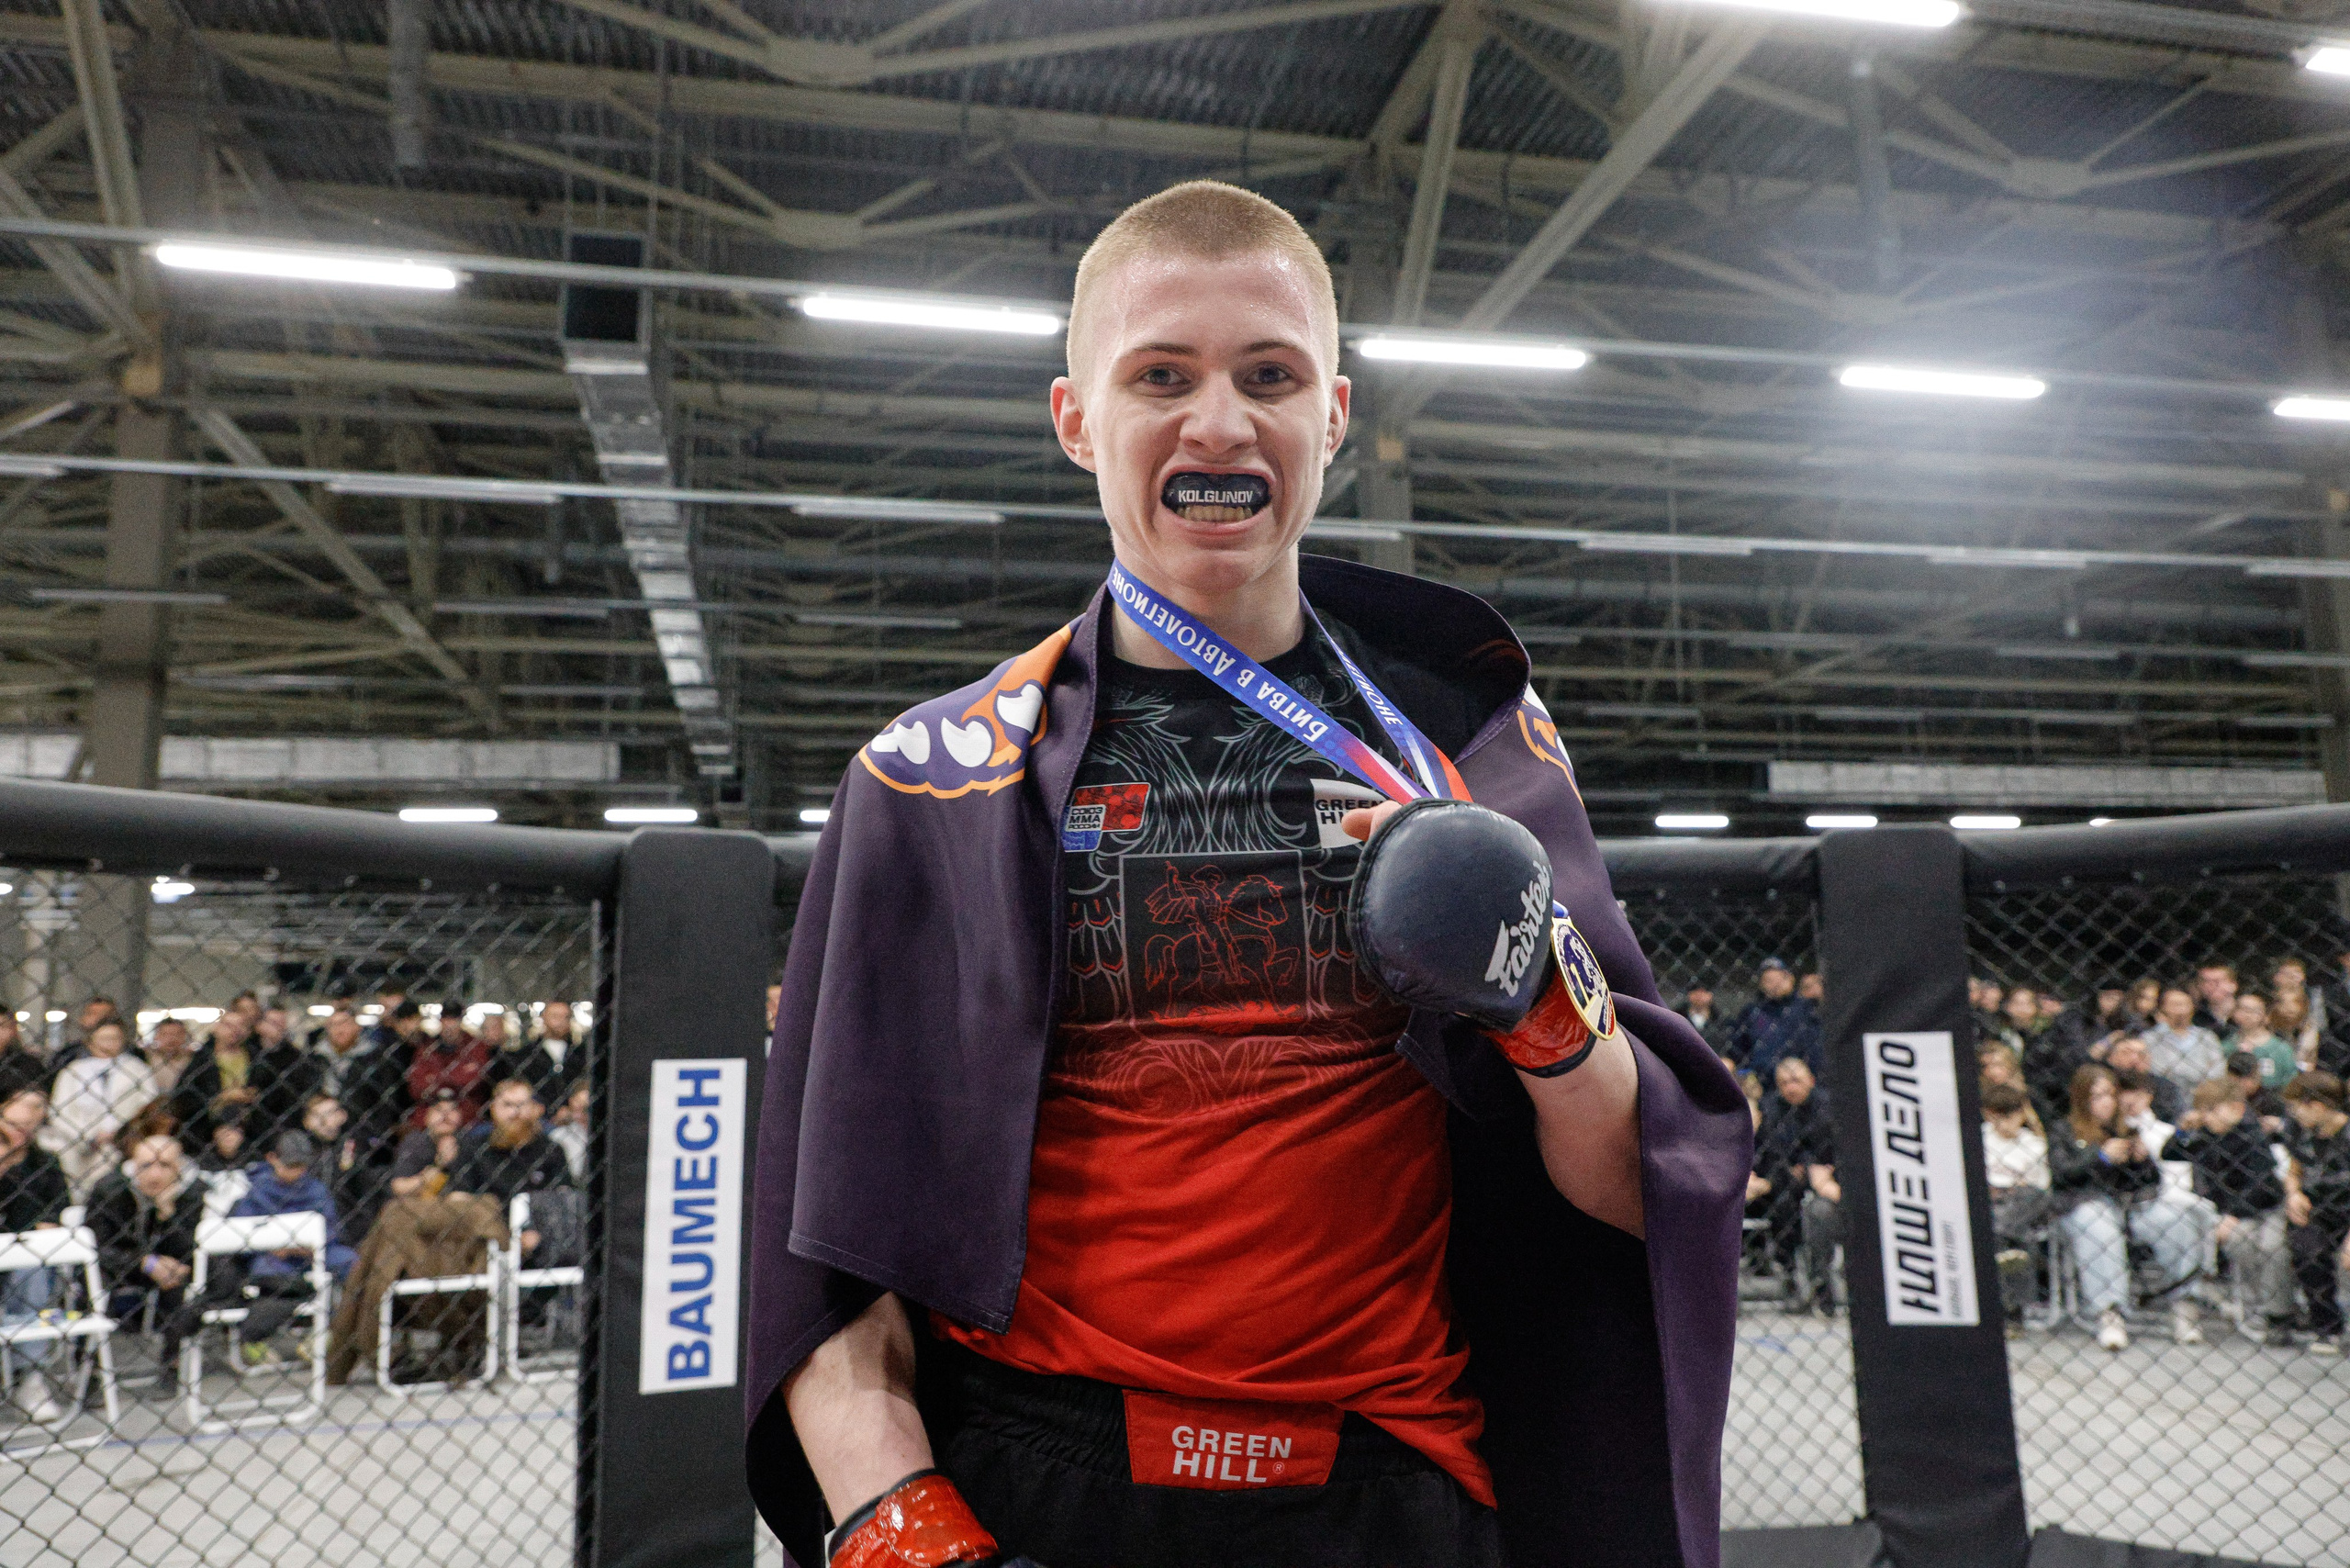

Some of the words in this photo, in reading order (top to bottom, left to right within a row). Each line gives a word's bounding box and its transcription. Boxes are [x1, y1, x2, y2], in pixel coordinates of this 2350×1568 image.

[1178, 489, 1254, 504] KOLGUNOV
[1113, 566, 1237, 677] АВТОЛЕГИОНЕ
[1256, 680, 1329, 743] БИТВА
[1879, 1041, 1926, 1164] ДЕЛО
[666, 1068, 722, 1381] BAUMECH
[1889, 1170, 1942, 1313] НАШЕ
[1171, 1425, 1292, 1459] GREEN
